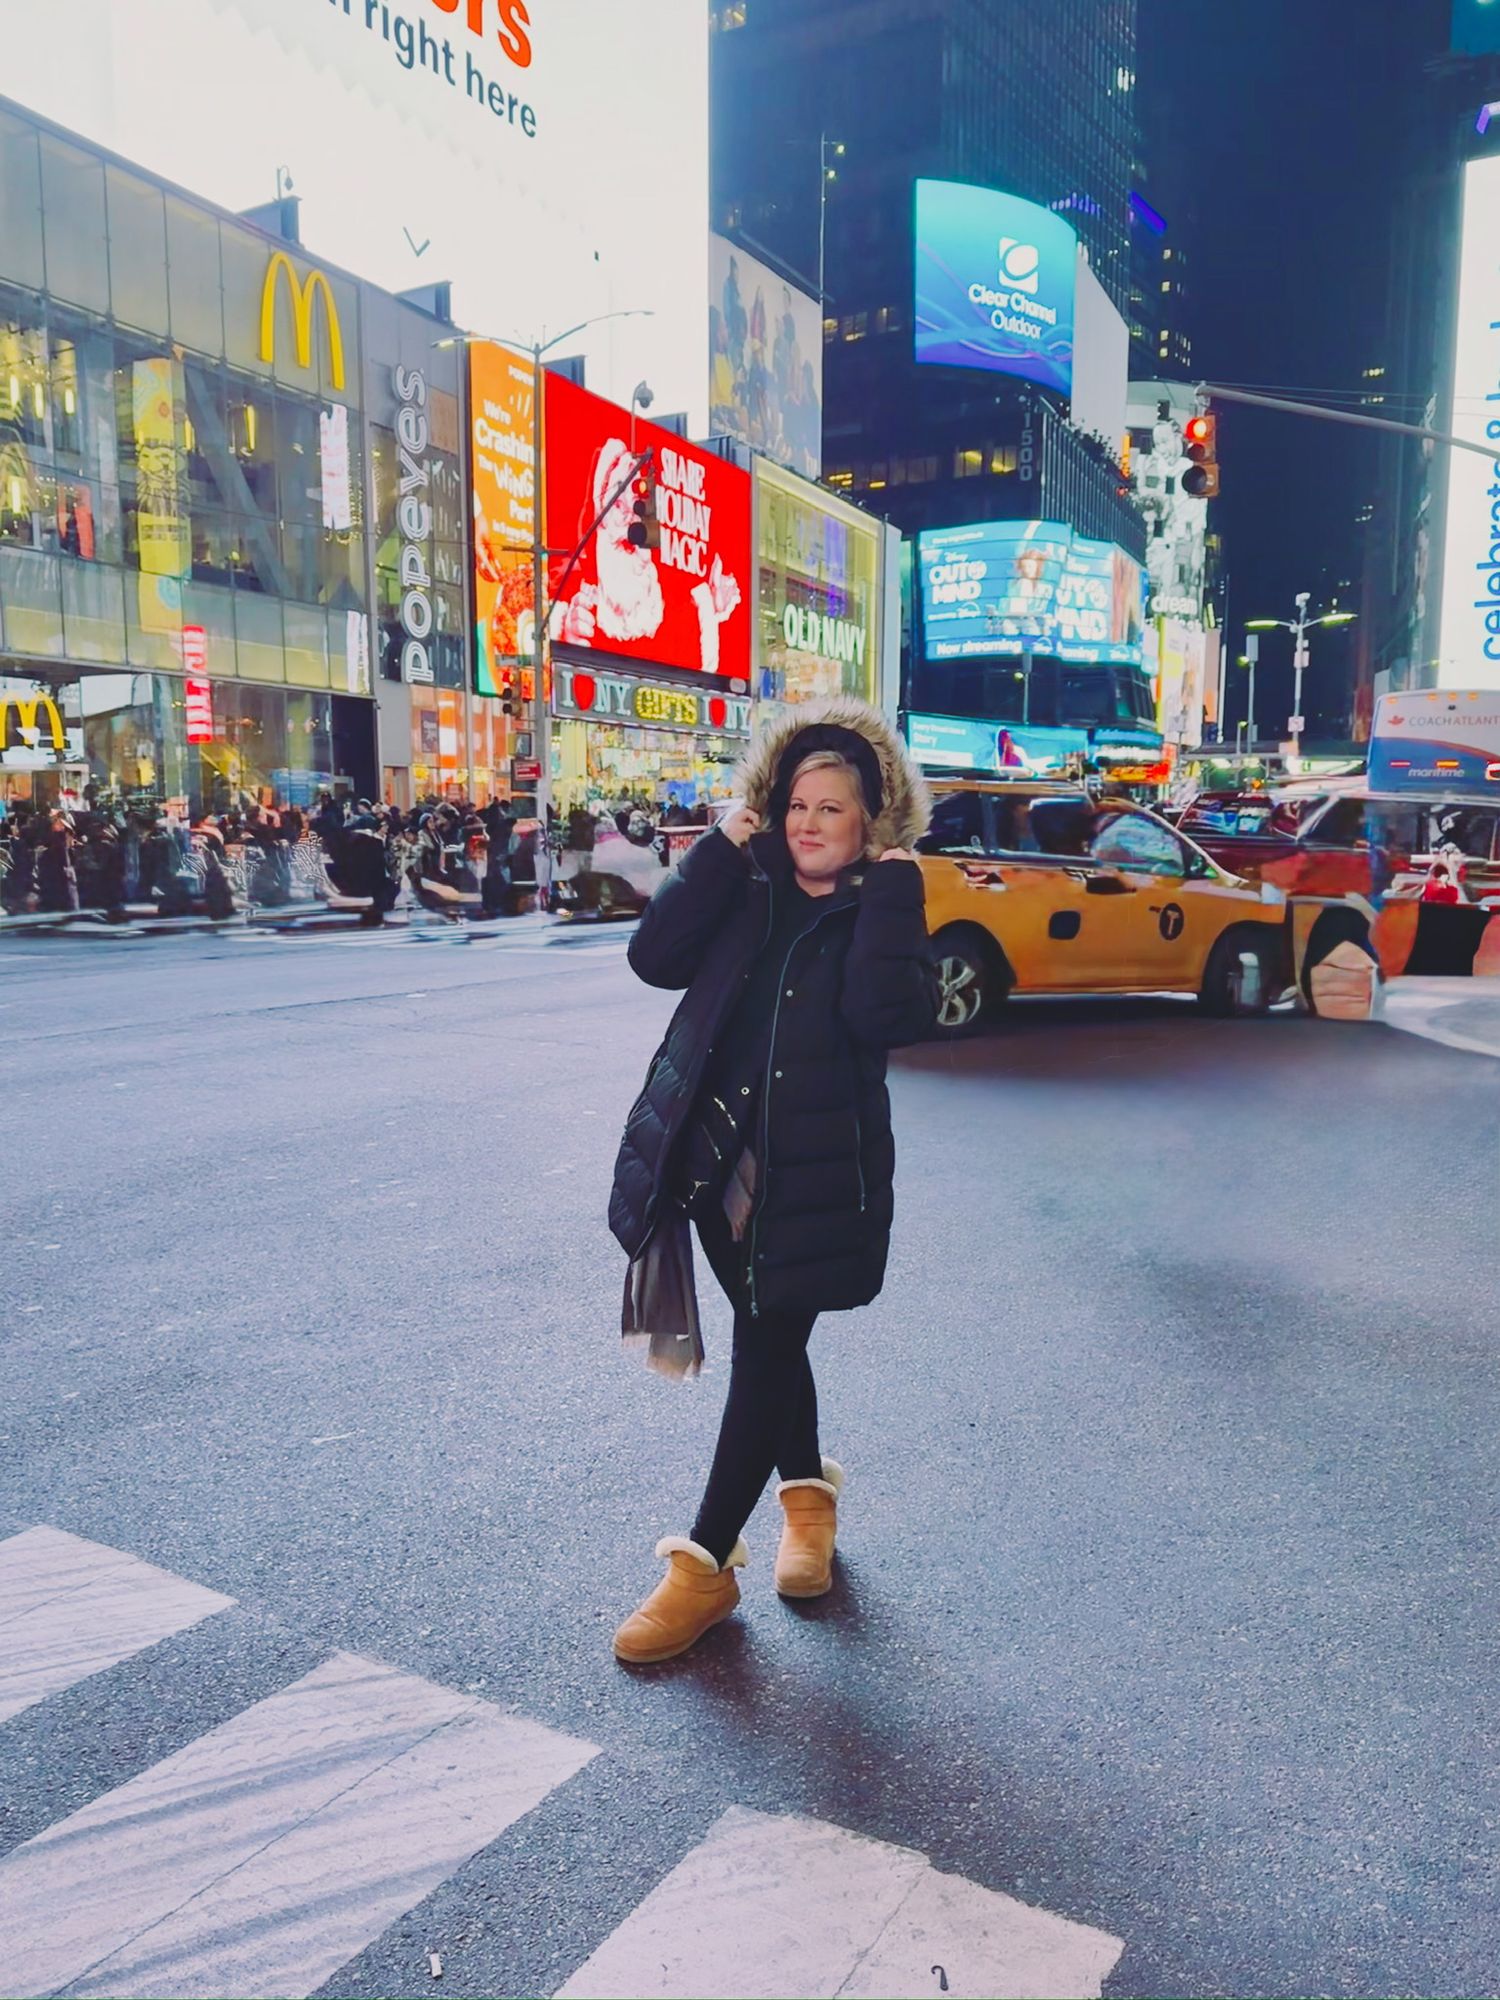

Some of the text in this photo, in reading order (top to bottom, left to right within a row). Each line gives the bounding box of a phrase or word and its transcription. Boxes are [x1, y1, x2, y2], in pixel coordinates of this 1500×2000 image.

[365, 0, 536, 138] right here
[968, 283, 1056, 325] Clear Channel
[991, 309, 1041, 339] Outdoor
[661, 447, 706, 501] SHARE
[783, 603, 866, 665] OLD NAVY
[635, 685, 697, 725] GIFTS
